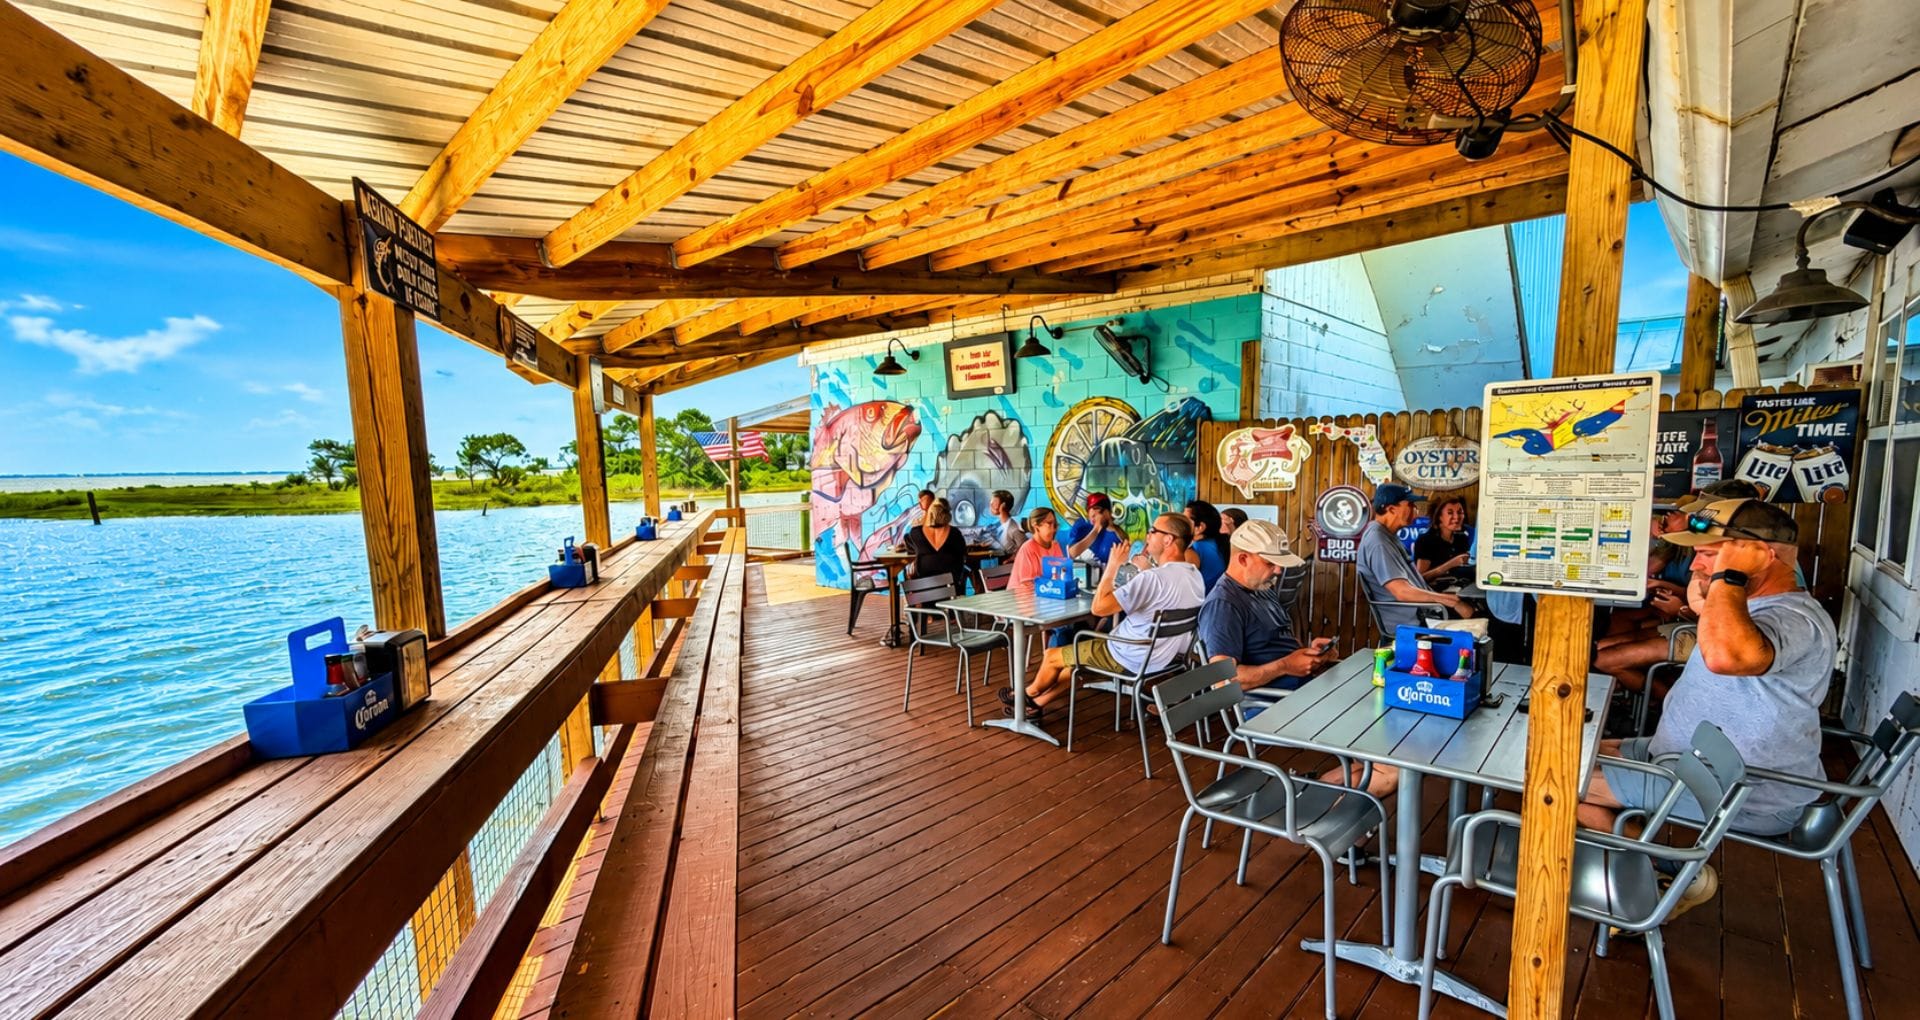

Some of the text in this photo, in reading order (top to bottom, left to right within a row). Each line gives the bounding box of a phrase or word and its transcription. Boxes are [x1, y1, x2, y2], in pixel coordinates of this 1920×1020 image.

[1755, 398, 1792, 408] TASTES
[1745, 403, 1843, 436] Miller
[1795, 423, 1850, 437] TIME.
[1404, 449, 1477, 464] OYSTER
[1418, 464, 1462, 478] CITY
[1746, 457, 1788, 480] Lite
[1799, 460, 1845, 486] Lite
[1327, 539, 1355, 550] BUD
[1320, 549, 1357, 560] LIGHT
[1397, 686, 1452, 707] Corona
[355, 698, 389, 730] Corona
